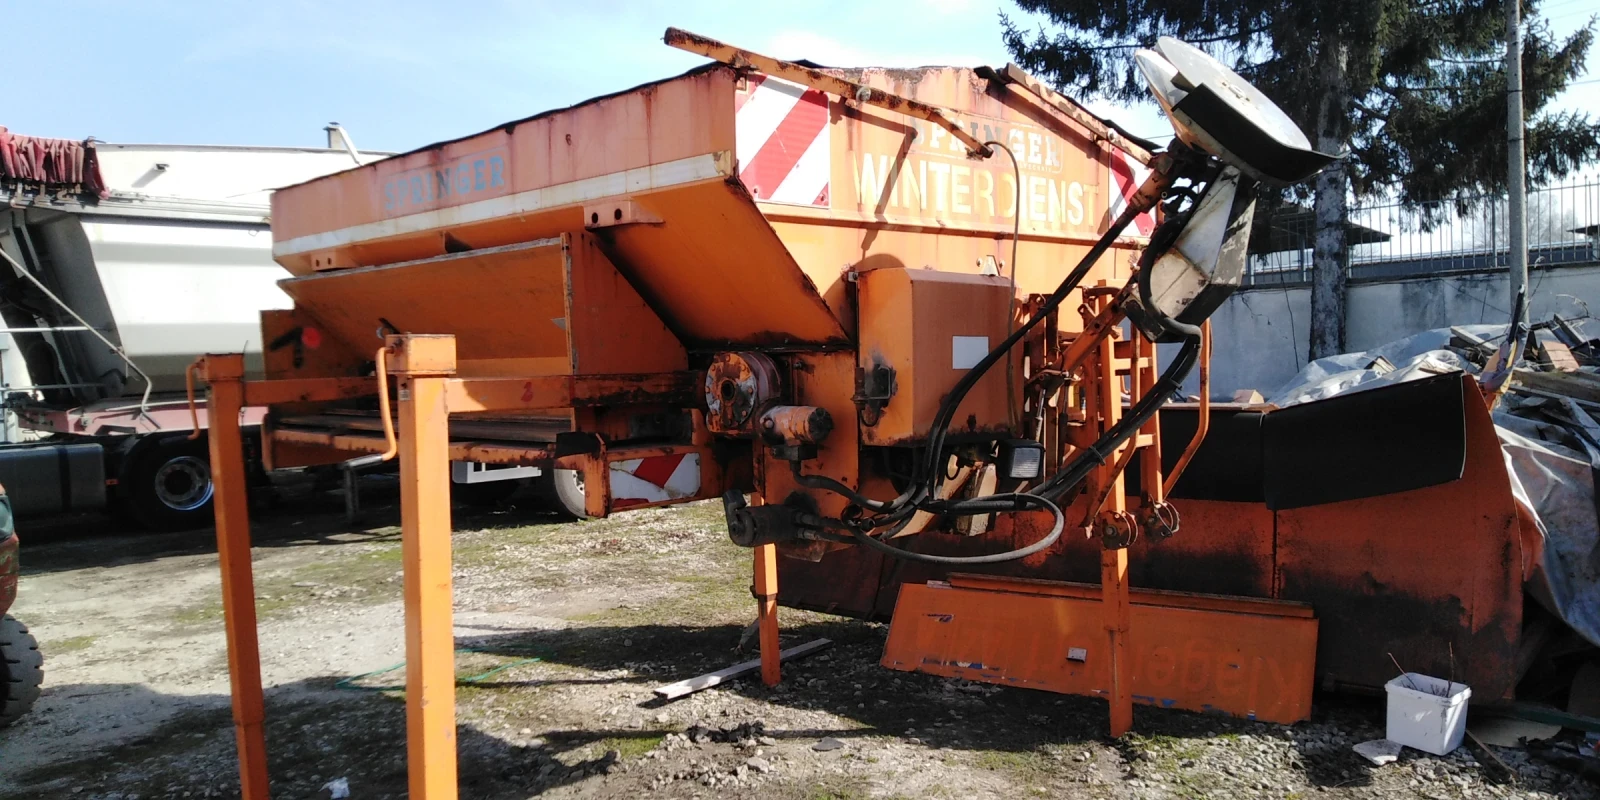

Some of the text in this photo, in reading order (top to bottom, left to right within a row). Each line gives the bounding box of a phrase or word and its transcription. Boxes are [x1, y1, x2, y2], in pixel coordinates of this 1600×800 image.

[909, 116, 1060, 167] SPRINGER
[385, 155, 505, 211] SPRINGER
[852, 152, 1099, 227] WINTERDIENST
